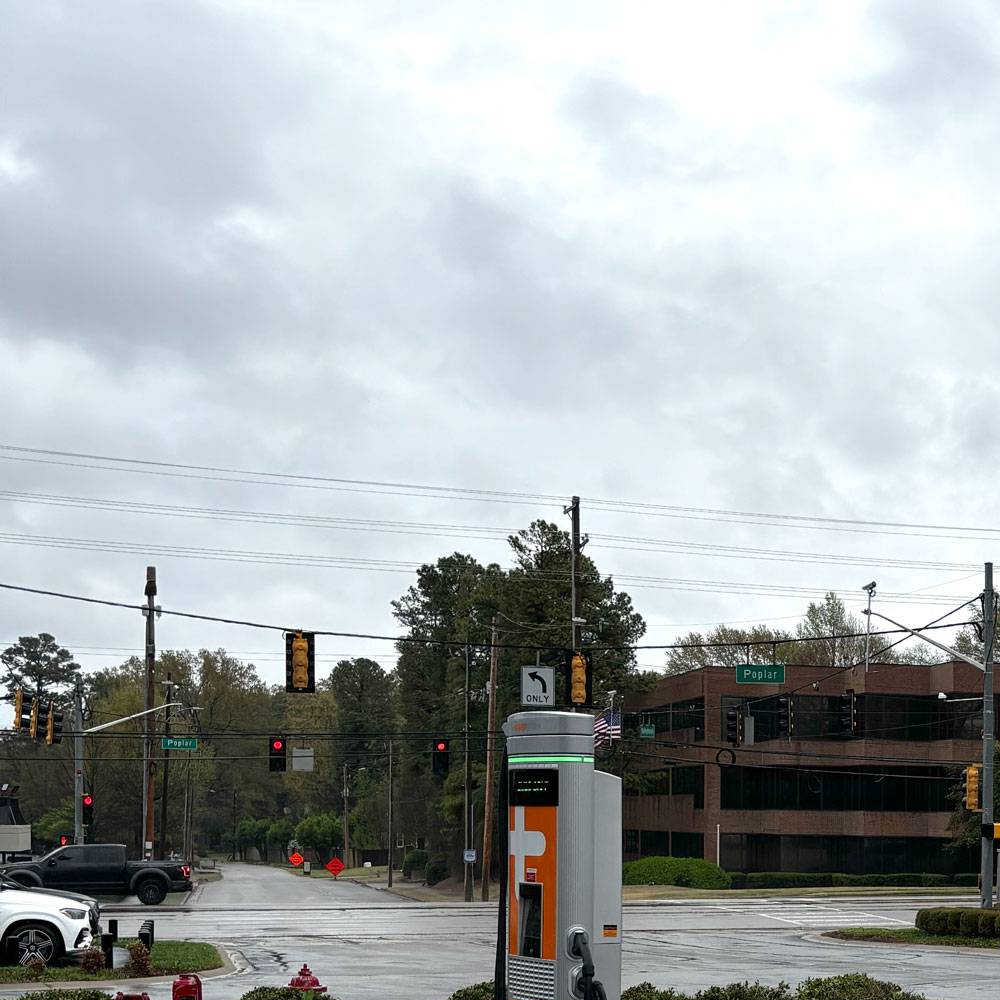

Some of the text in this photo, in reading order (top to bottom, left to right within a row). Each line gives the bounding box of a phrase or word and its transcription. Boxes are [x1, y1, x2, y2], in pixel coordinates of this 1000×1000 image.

[743, 669, 777, 680] Poplar
[526, 694, 549, 703] ONLY
[167, 739, 193, 748] Poplar
